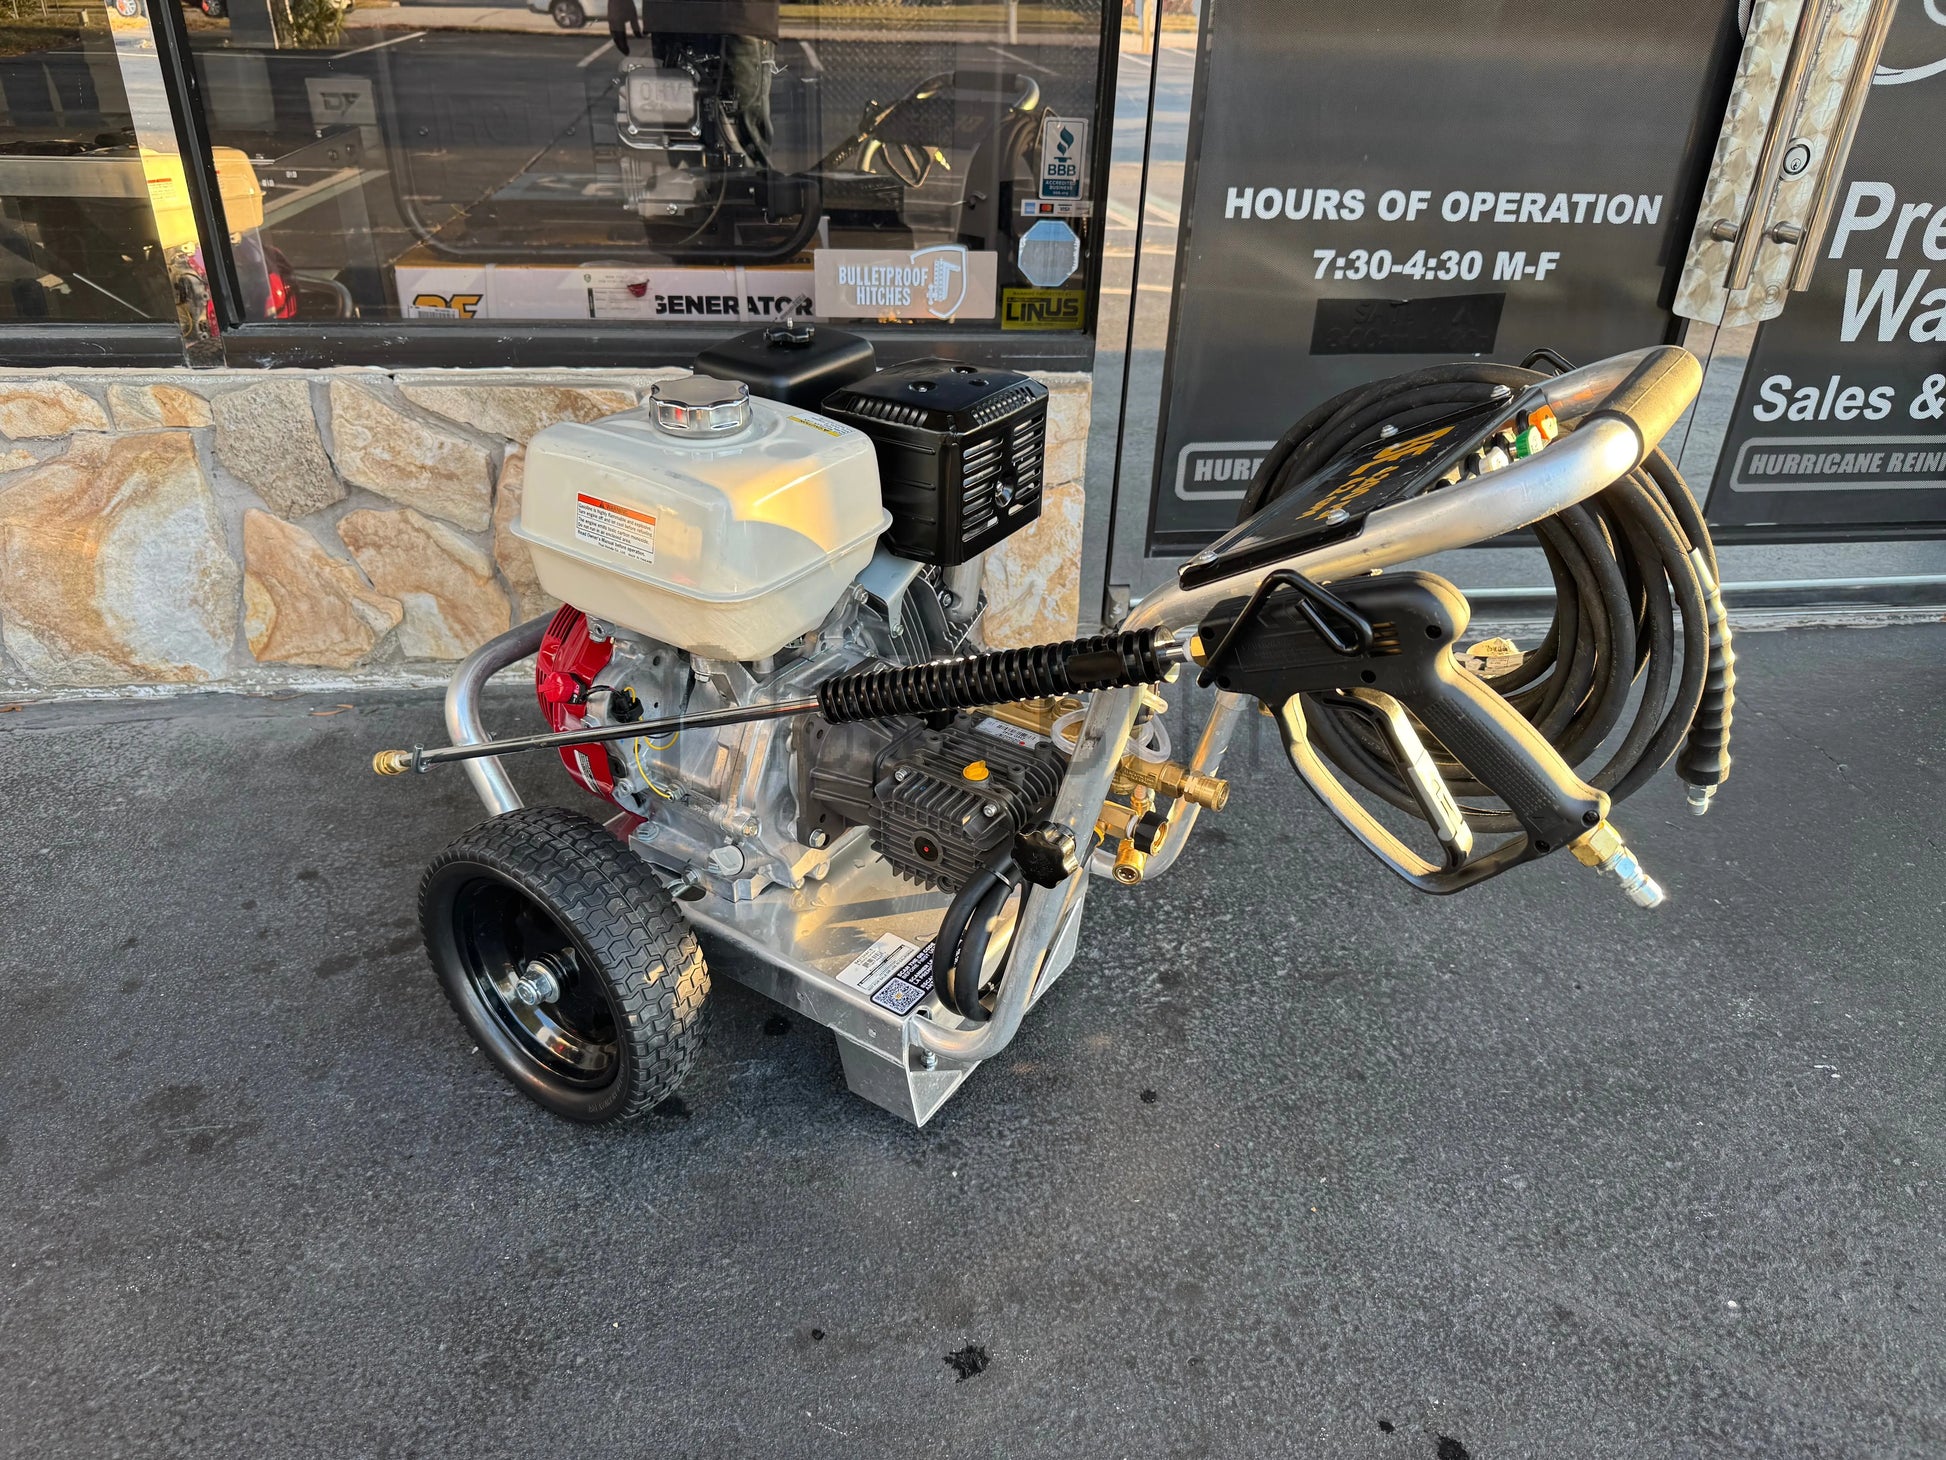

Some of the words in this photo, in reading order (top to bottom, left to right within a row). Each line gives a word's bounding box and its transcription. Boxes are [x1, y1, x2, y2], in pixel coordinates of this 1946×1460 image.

[1047, 164, 1076, 176] BBB
[1224, 187, 1365, 220] HOURS
[1377, 190, 1431, 222] OF
[1441, 191, 1663, 225] OPERATION
[838, 265, 929, 287] BULLETPROOF
[1312, 249, 1482, 280] 7:30-4:30
[1492, 251, 1560, 280] M-F
[856, 286, 911, 306] HITCHES
[1006, 297, 1079, 321] LINUS
[1753, 375, 1895, 421] Sales
[1909, 373, 1946, 420] &
[1749, 453, 1885, 476] HURRICANE
